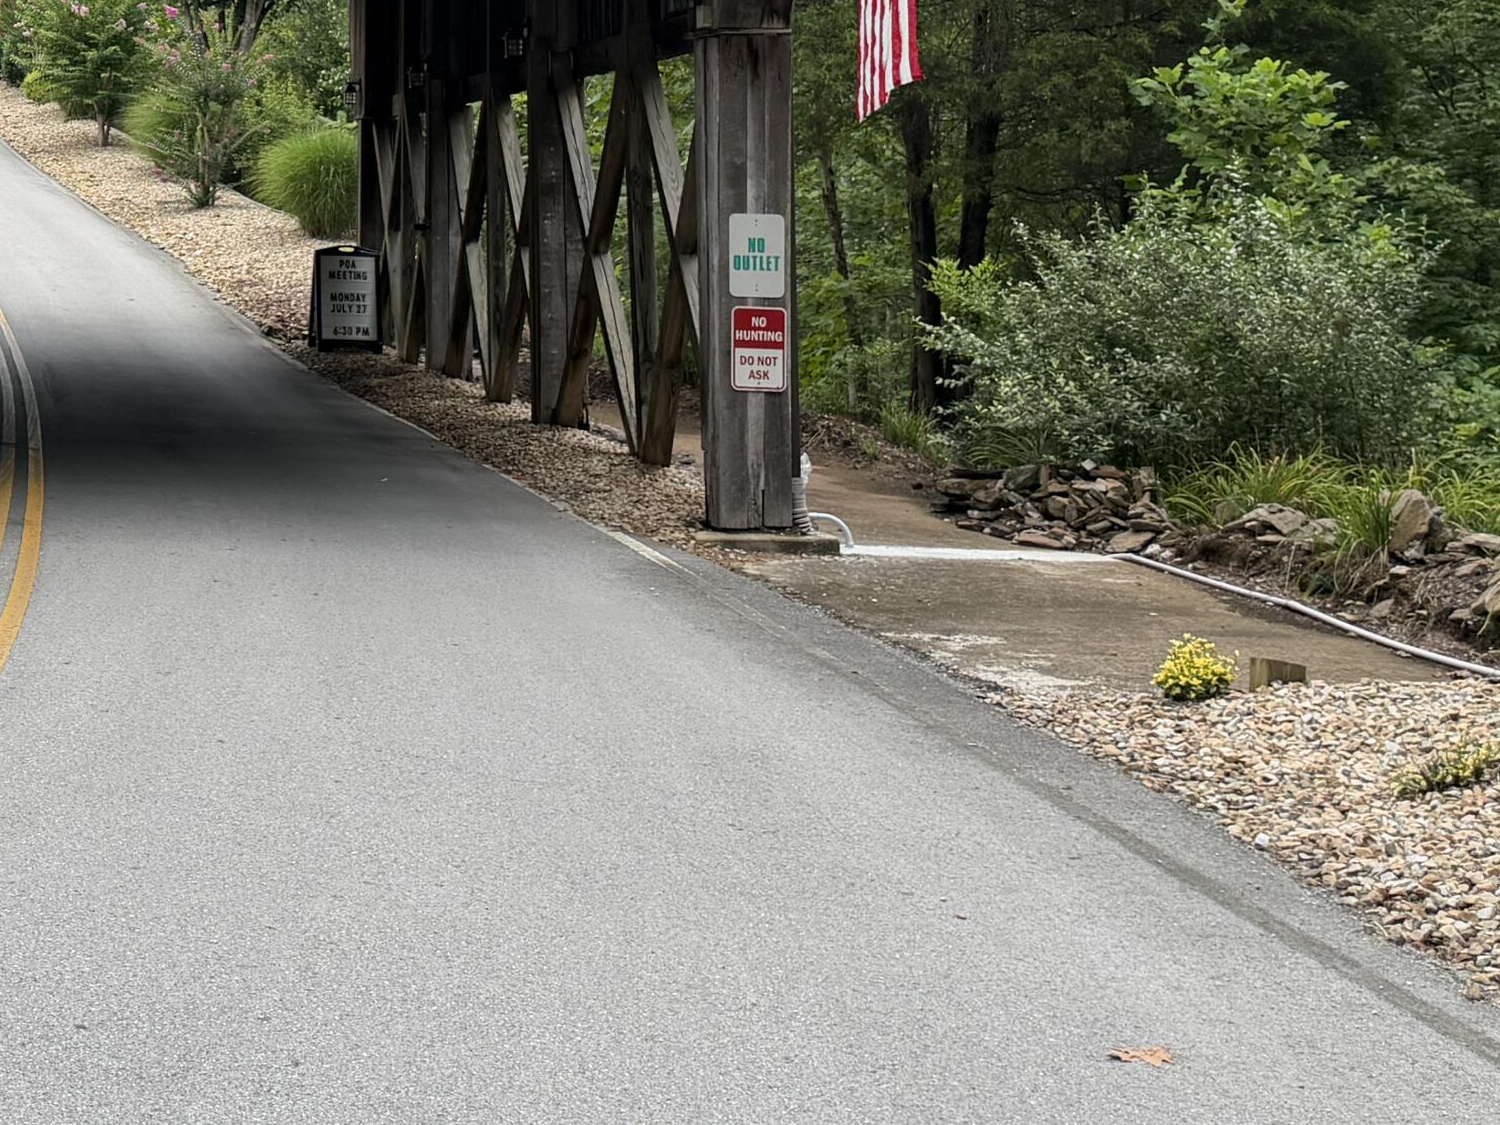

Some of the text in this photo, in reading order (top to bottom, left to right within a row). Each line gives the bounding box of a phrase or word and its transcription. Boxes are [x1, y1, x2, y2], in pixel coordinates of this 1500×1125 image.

[748, 237, 765, 253] NO
[339, 259, 356, 269] POA
[733, 255, 780, 272] OUTLET
[328, 270, 368, 281] MEETING
[330, 292, 367, 303] MONDAY
[330, 303, 367, 314] JULY 27
[751, 316, 767, 328] NO
[333, 326, 370, 336] 6:30 PM
[735, 330, 783, 342] HUNTING
[740, 355, 778, 367] DO NOT
[748, 369, 770, 380] ASK
